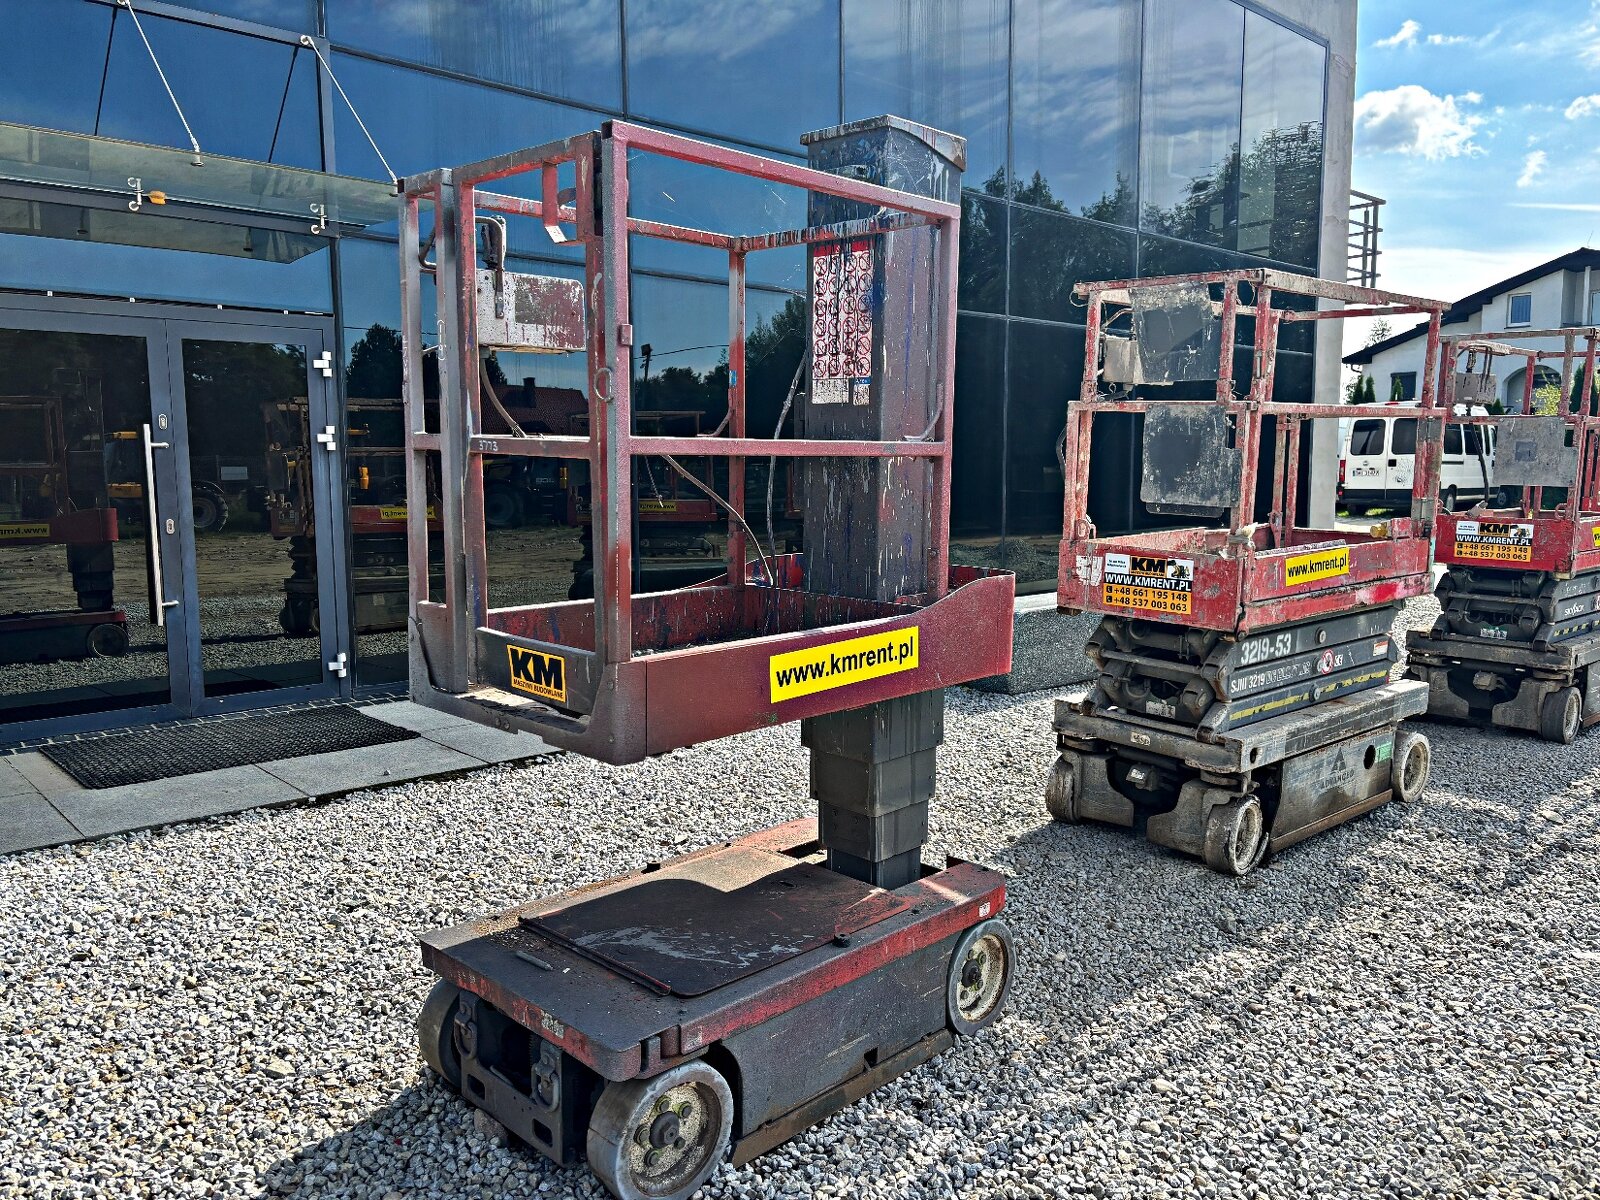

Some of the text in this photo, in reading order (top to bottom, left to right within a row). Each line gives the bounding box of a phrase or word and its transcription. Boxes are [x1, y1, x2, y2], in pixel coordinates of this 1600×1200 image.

[479, 440, 498, 452] 3773
[1479, 522, 1510, 534] KM
[1456, 534, 1531, 546] WWW.KMRENT.PL
[1131, 557, 1166, 573] KM
[1287, 553, 1347, 578] www.kmrent.pl
[1105, 573, 1191, 591] WWW.KMRENT.PL
[1114, 585, 1188, 602] +48 661 195 148
[1113, 595, 1187, 612] +48 537 003 063
[1240, 632, 1292, 666] 3219-53
[510, 647, 563, 691] KM
[776, 636, 914, 688] www.kmrent.pl
[1248, 673, 1266, 690] 3219
[533, 684, 563, 698] BUDOWLANE
